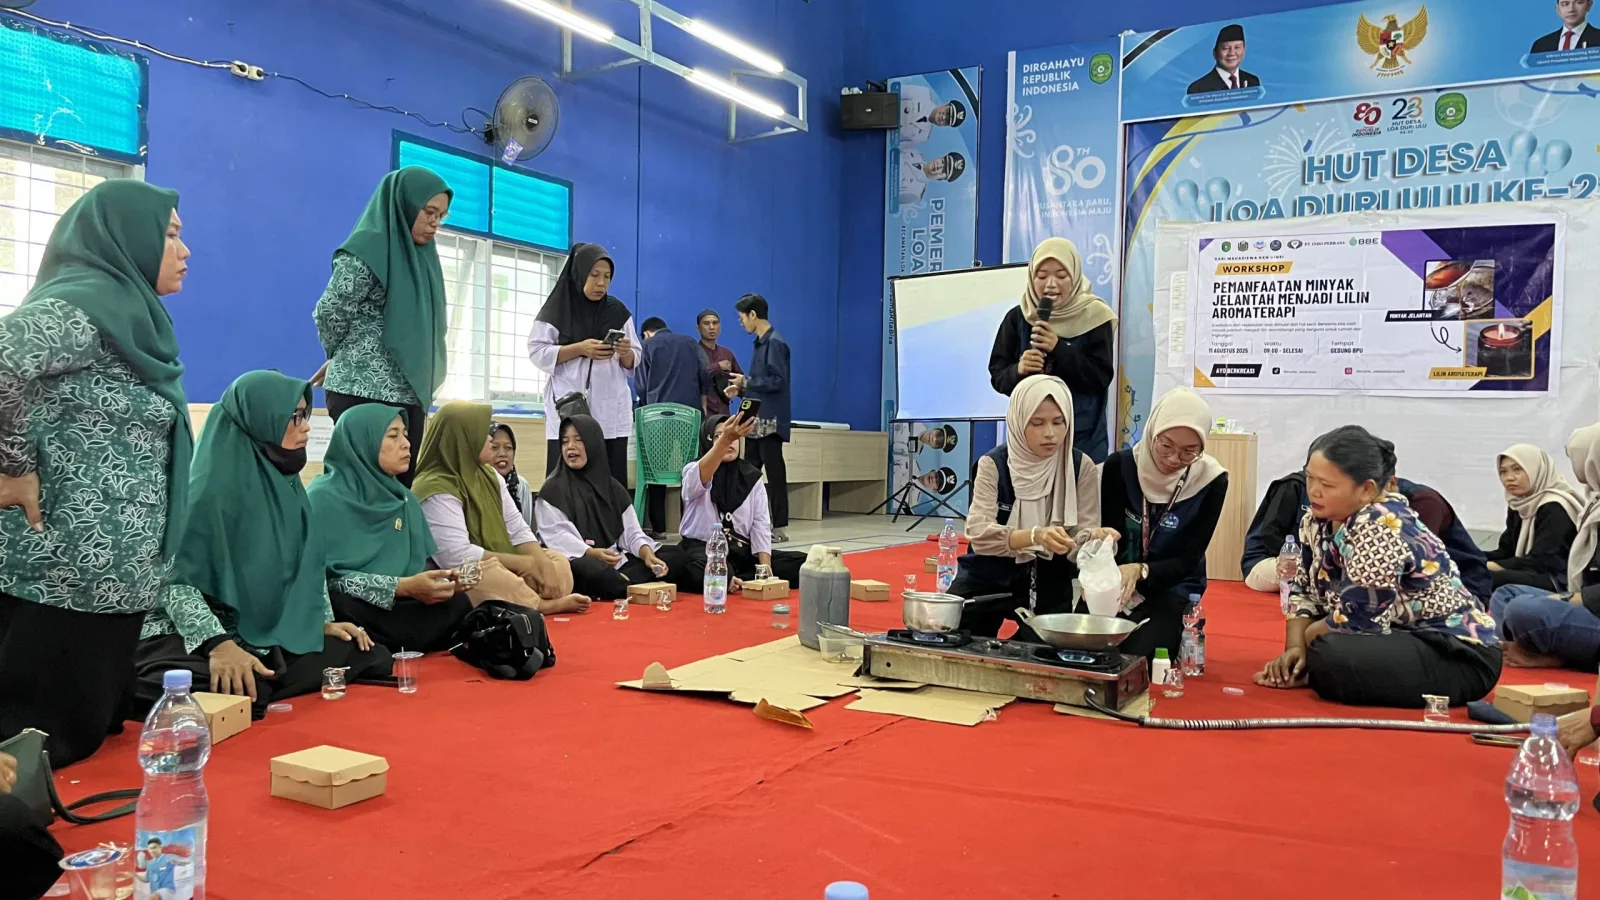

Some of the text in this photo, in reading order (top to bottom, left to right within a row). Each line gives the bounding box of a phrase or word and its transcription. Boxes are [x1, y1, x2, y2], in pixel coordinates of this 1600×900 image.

[1023, 57, 1085, 73] DIRGAHAYU
[1023, 71, 1071, 84] REPUBLIK
[1022, 82, 1079, 96] INDONESIA
[1353, 102, 1382, 125] 80
[1392, 96, 1423, 120] 23
[1076, 147, 1091, 156] TH
[1304, 138, 1509, 185] HUT DESA
[1046, 145, 1106, 195] 80
[1088, 207, 1112, 216] MAJU
[912, 228, 926, 273] LOA
[1222, 264, 1285, 273] WORKSHOP
[1214, 278, 1354, 294] PEMANFAATAN MINYAK
[1212, 291, 1370, 306] JELANTAH MENJADI LILIN
[1212, 306, 1296, 319] AROMATERAPI
